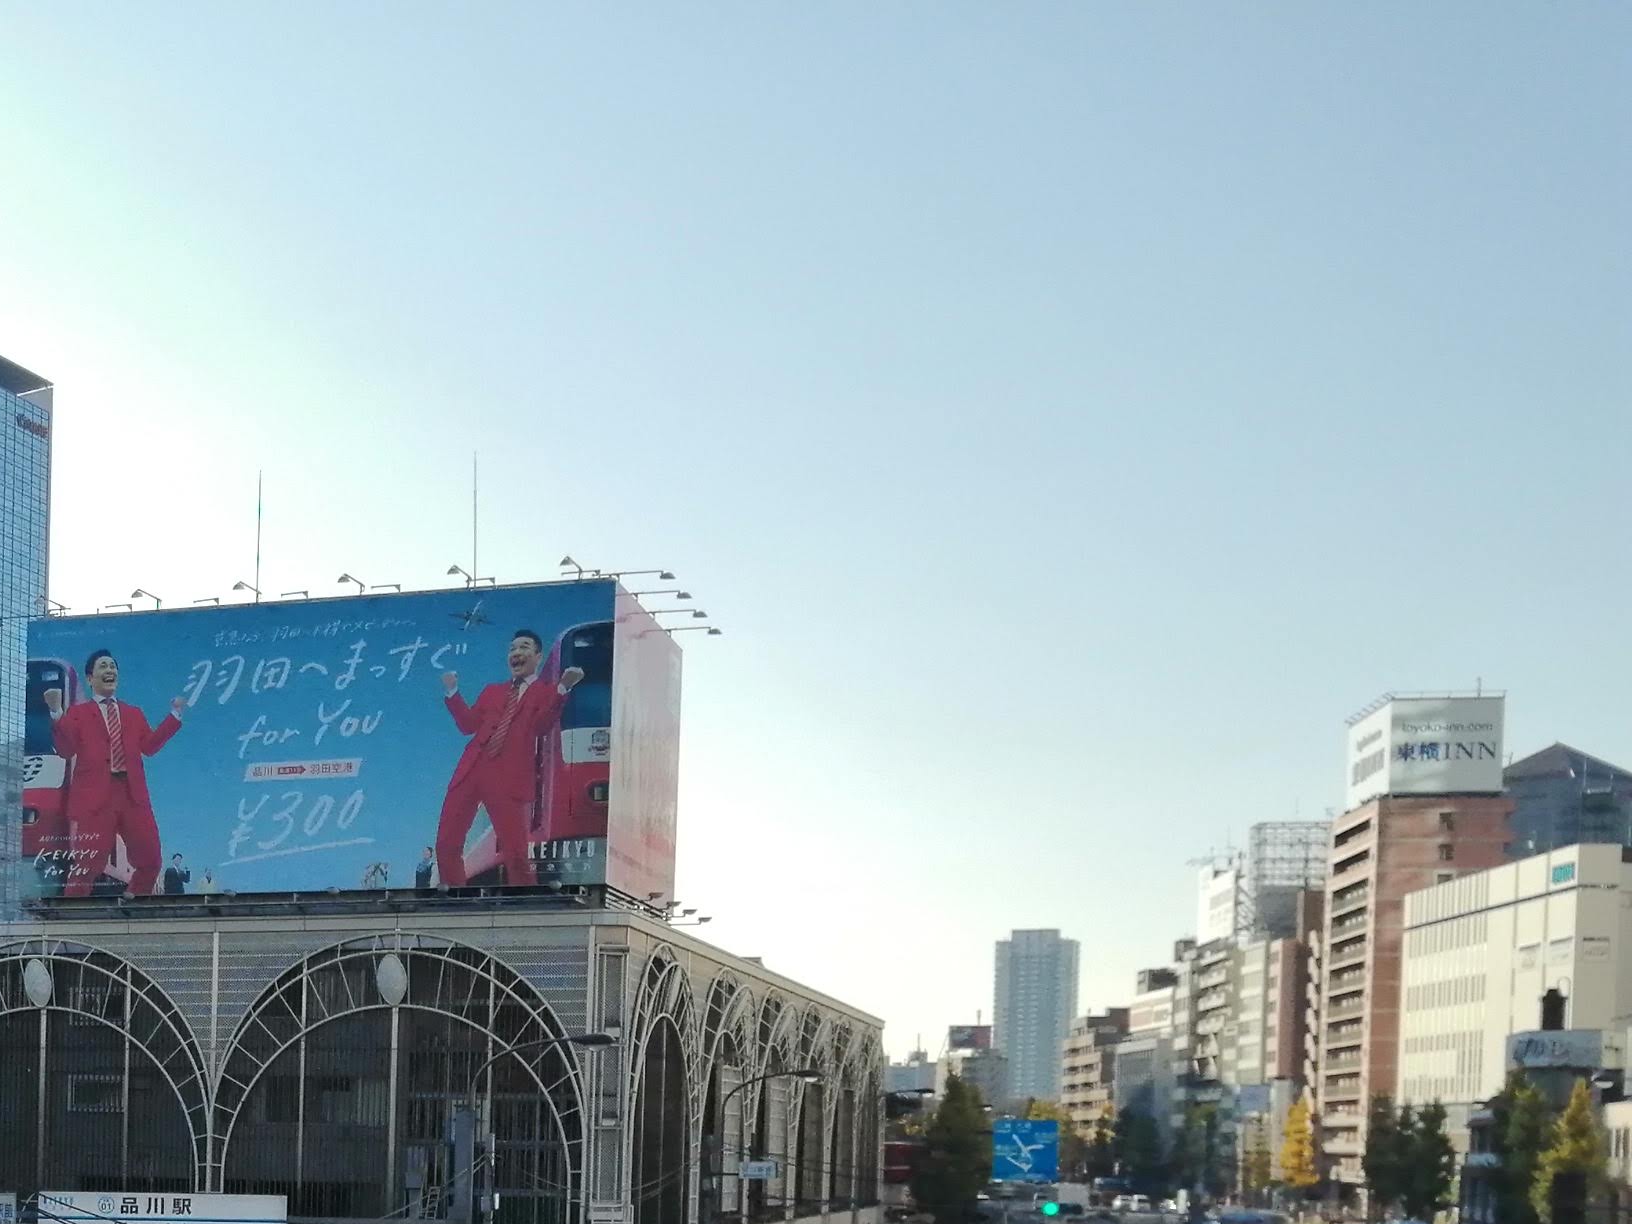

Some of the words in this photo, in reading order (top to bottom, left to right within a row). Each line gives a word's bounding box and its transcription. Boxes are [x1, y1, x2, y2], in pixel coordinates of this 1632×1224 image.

[183, 636, 467, 707] 羽田へまっすぐ
[238, 715, 300, 759] for
[314, 699, 383, 745] You
[229, 789, 364, 857] ¥300
[34, 847, 98, 866] KEIKYU
[528, 840, 595, 859] KEIKYU
[45, 865, 64, 879] for
[68, 863, 89, 879] You
[120, 1197, 192, 1216] 品川駅
